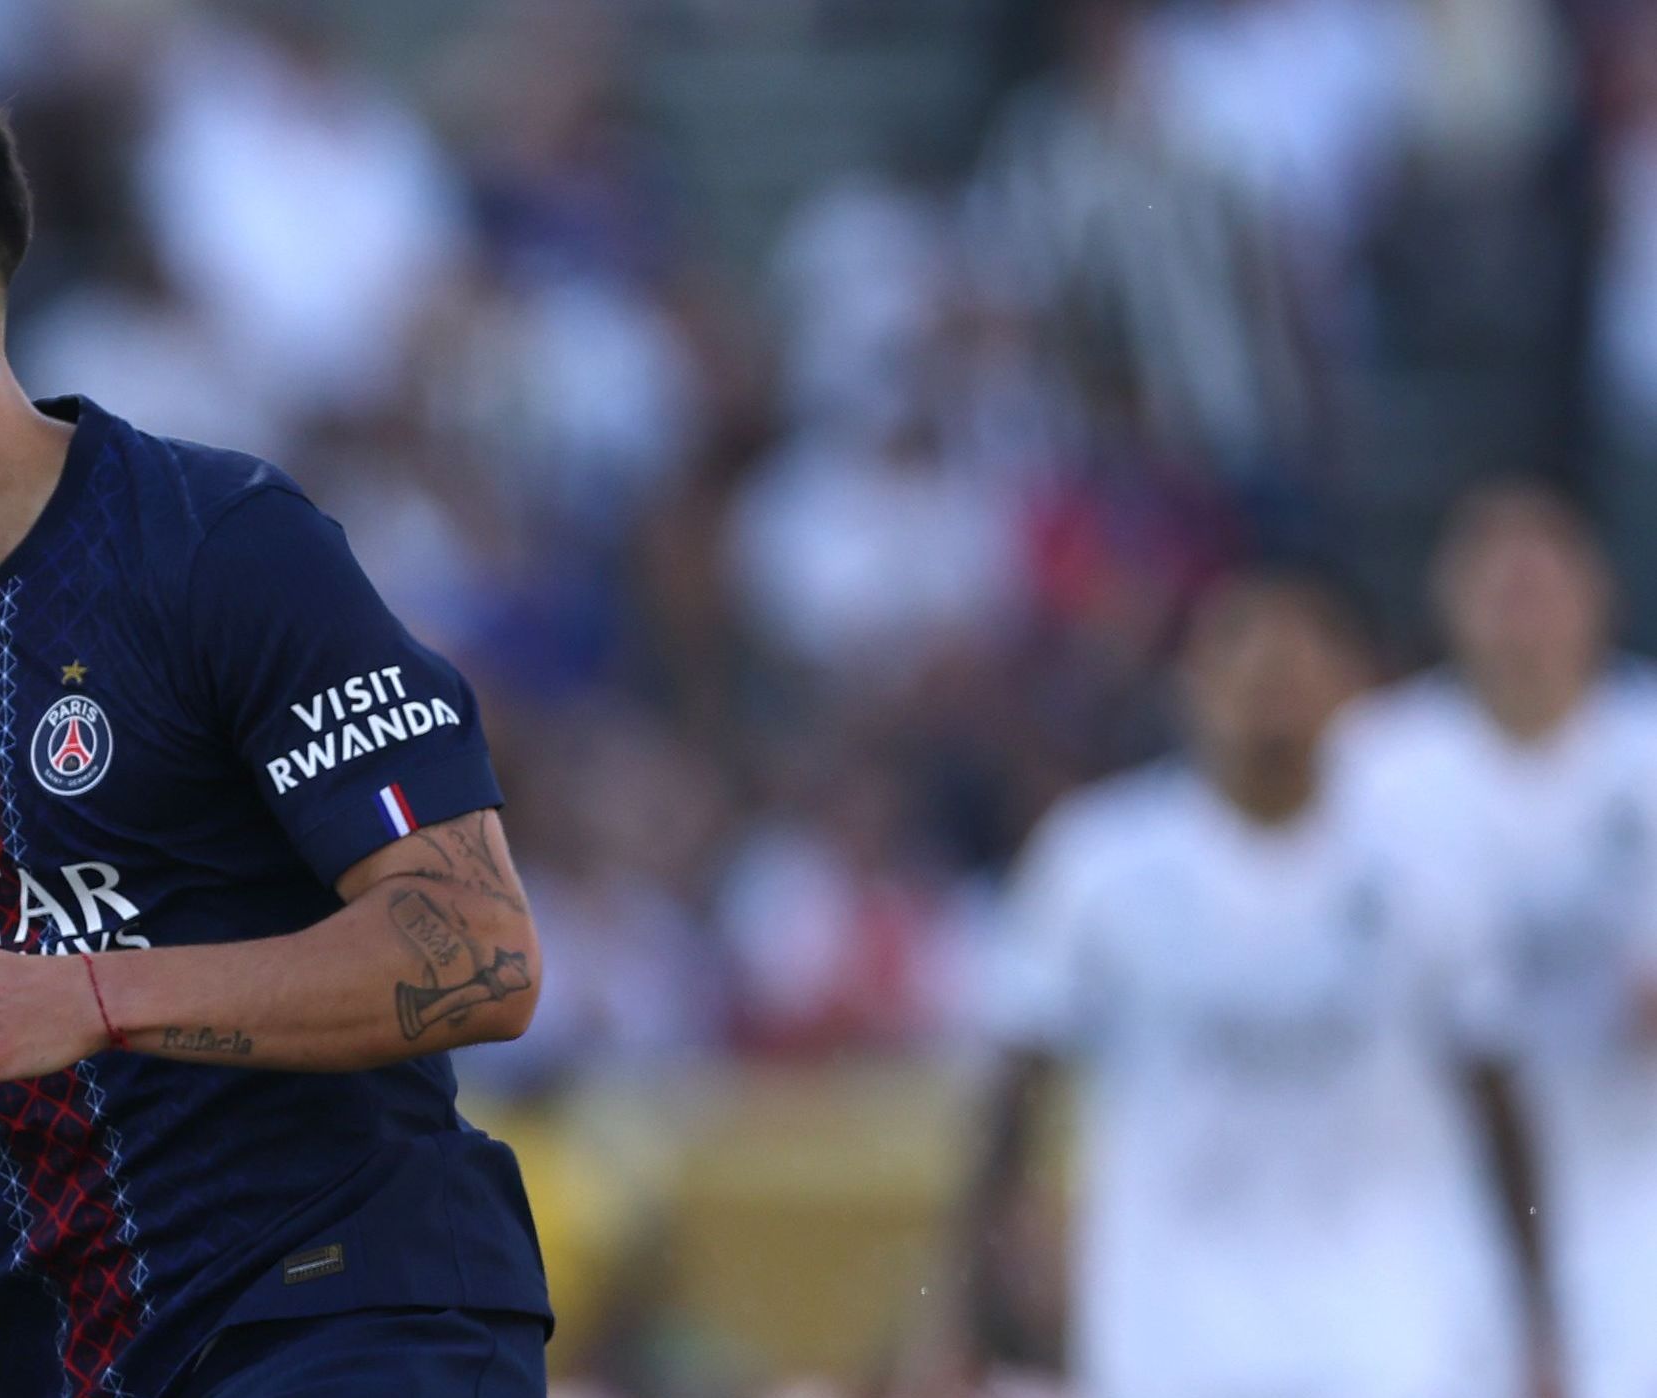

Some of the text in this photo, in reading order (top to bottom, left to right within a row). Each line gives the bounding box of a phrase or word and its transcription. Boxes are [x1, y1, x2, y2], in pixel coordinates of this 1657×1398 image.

[48, 700, 98, 727] PARIS
[290, 665, 406, 732] VISIT
[266, 697, 461, 795] RWANDA
